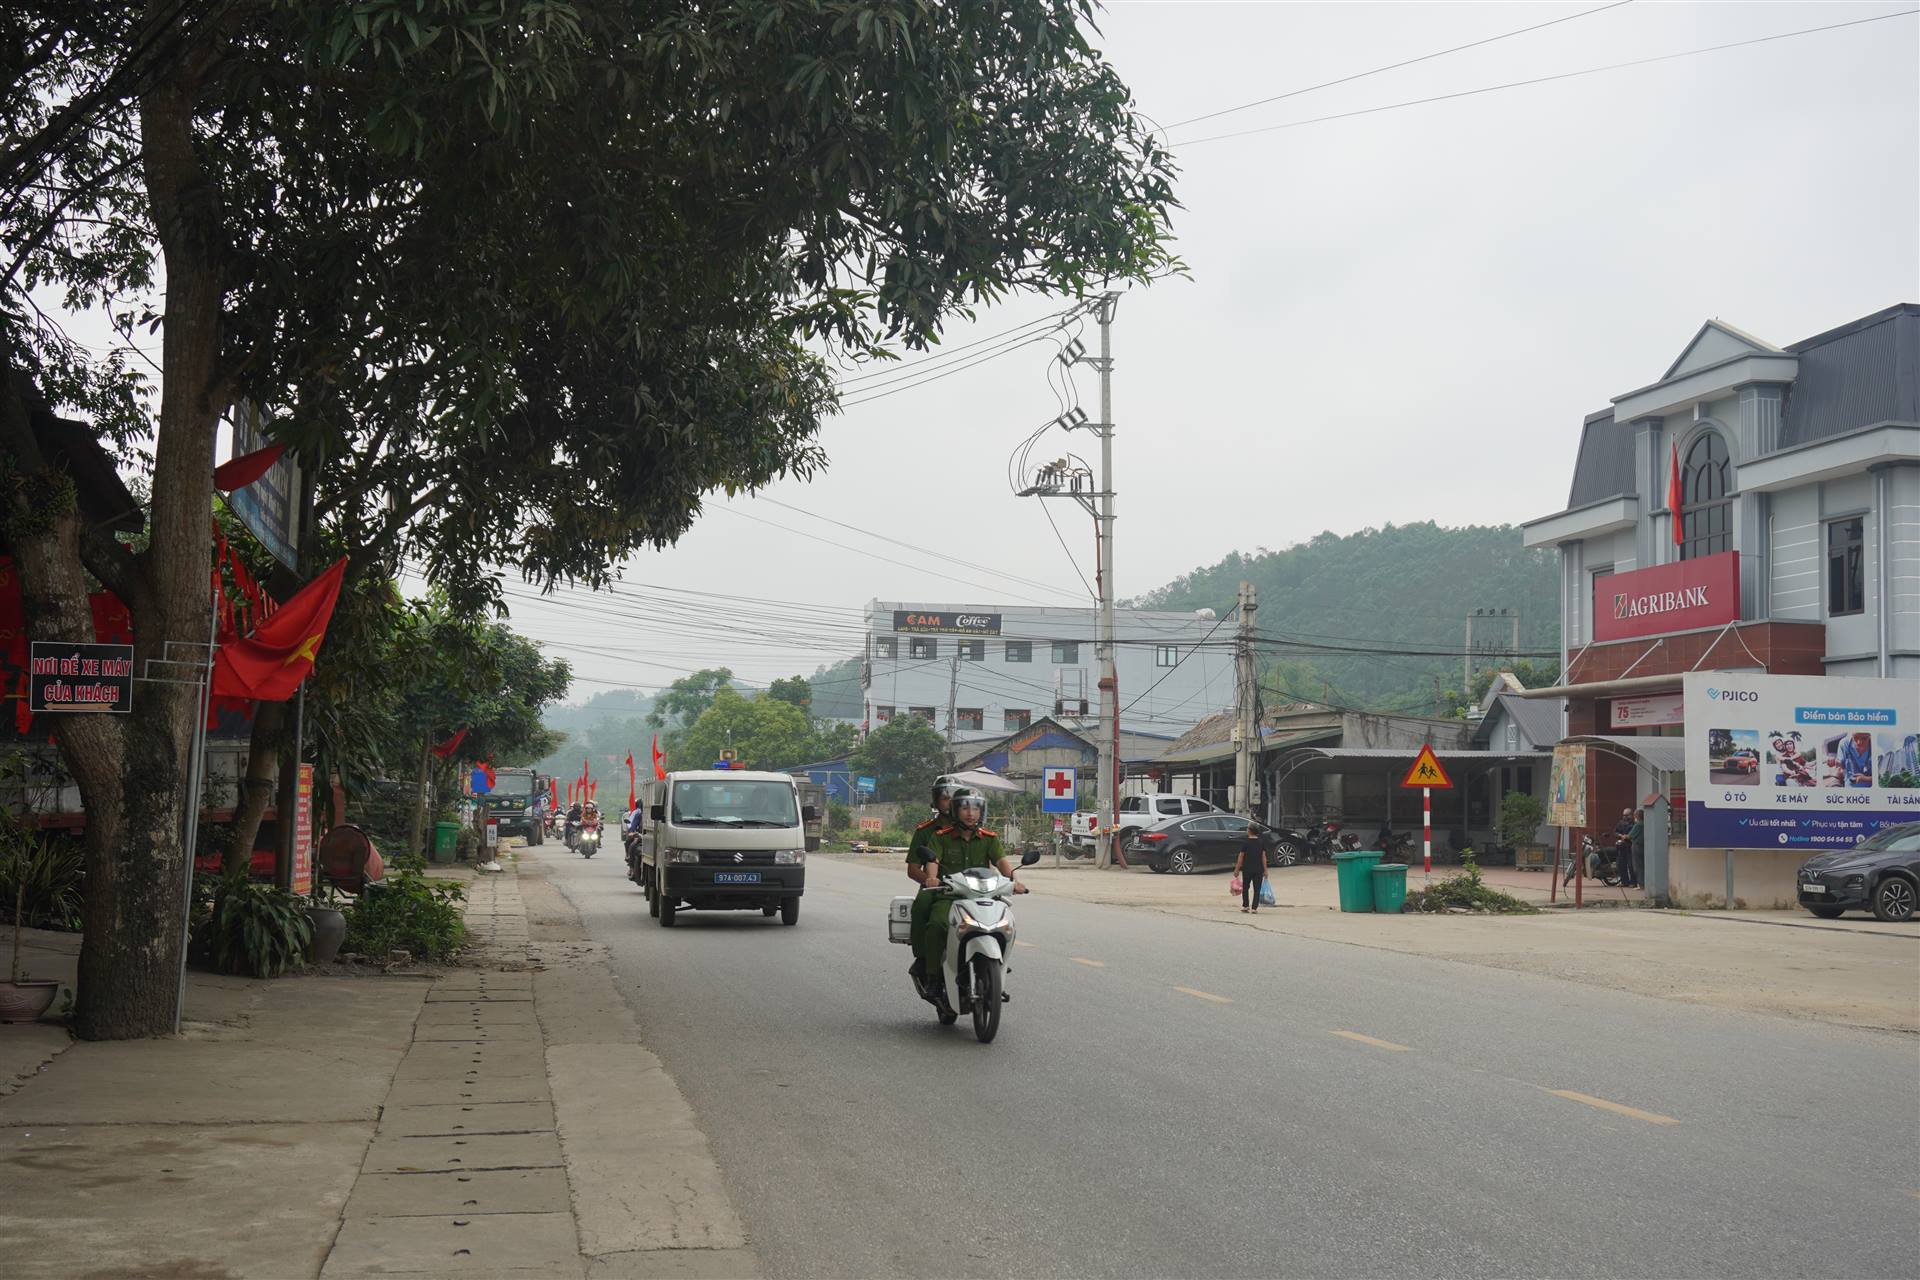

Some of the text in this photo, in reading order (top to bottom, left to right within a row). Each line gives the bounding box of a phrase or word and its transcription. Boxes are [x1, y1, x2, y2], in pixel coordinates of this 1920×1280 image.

[1628, 585, 1710, 617] AGRIBANK
[906, 614, 991, 627] CAM Coffee
[33, 652, 131, 677] NƠI ĐỂ XE MÁY
[44, 680, 120, 703] CỦA KHÁCH
[1722, 690, 1759, 702] PJICO
[1617, 706, 1629, 719] 75
[1802, 709, 1889, 722] Điểm bán Bảo hiểm
[1724, 792, 1747, 802] Ô TÔ
[1776, 793, 1809, 803] XE MÁY
[1826, 793, 1847, 804] SỨC
[1887, 794, 1901, 805] TÀI
